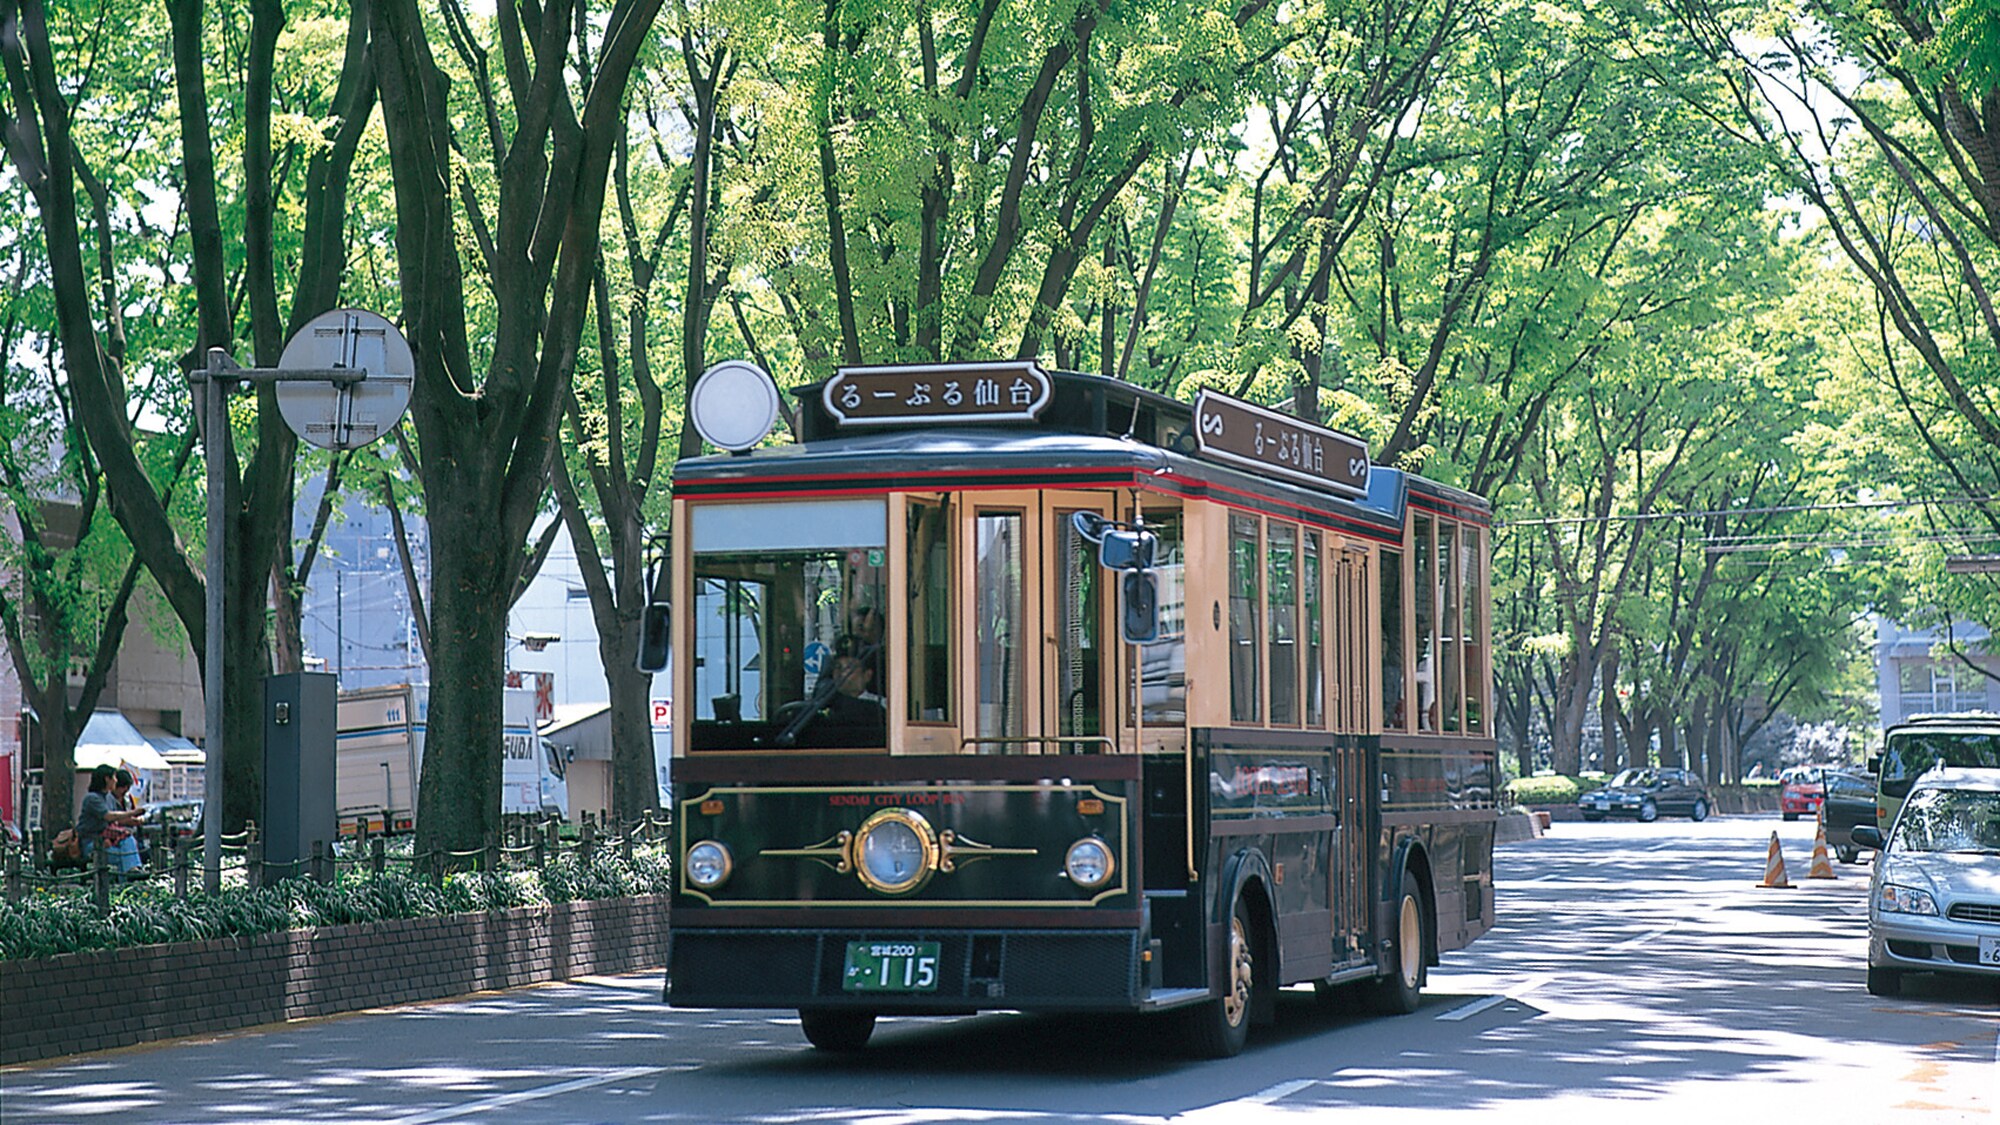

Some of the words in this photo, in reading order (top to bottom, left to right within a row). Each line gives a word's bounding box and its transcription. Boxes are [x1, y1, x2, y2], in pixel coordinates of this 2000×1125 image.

[841, 378, 1033, 409] るーぷる仙台
[1254, 421, 1324, 474] るーぷる仙台
[655, 706, 667, 721] P
[829, 795, 870, 806] SENDAI
[874, 795, 902, 806] CITY
[906, 794, 938, 805] LOOP
